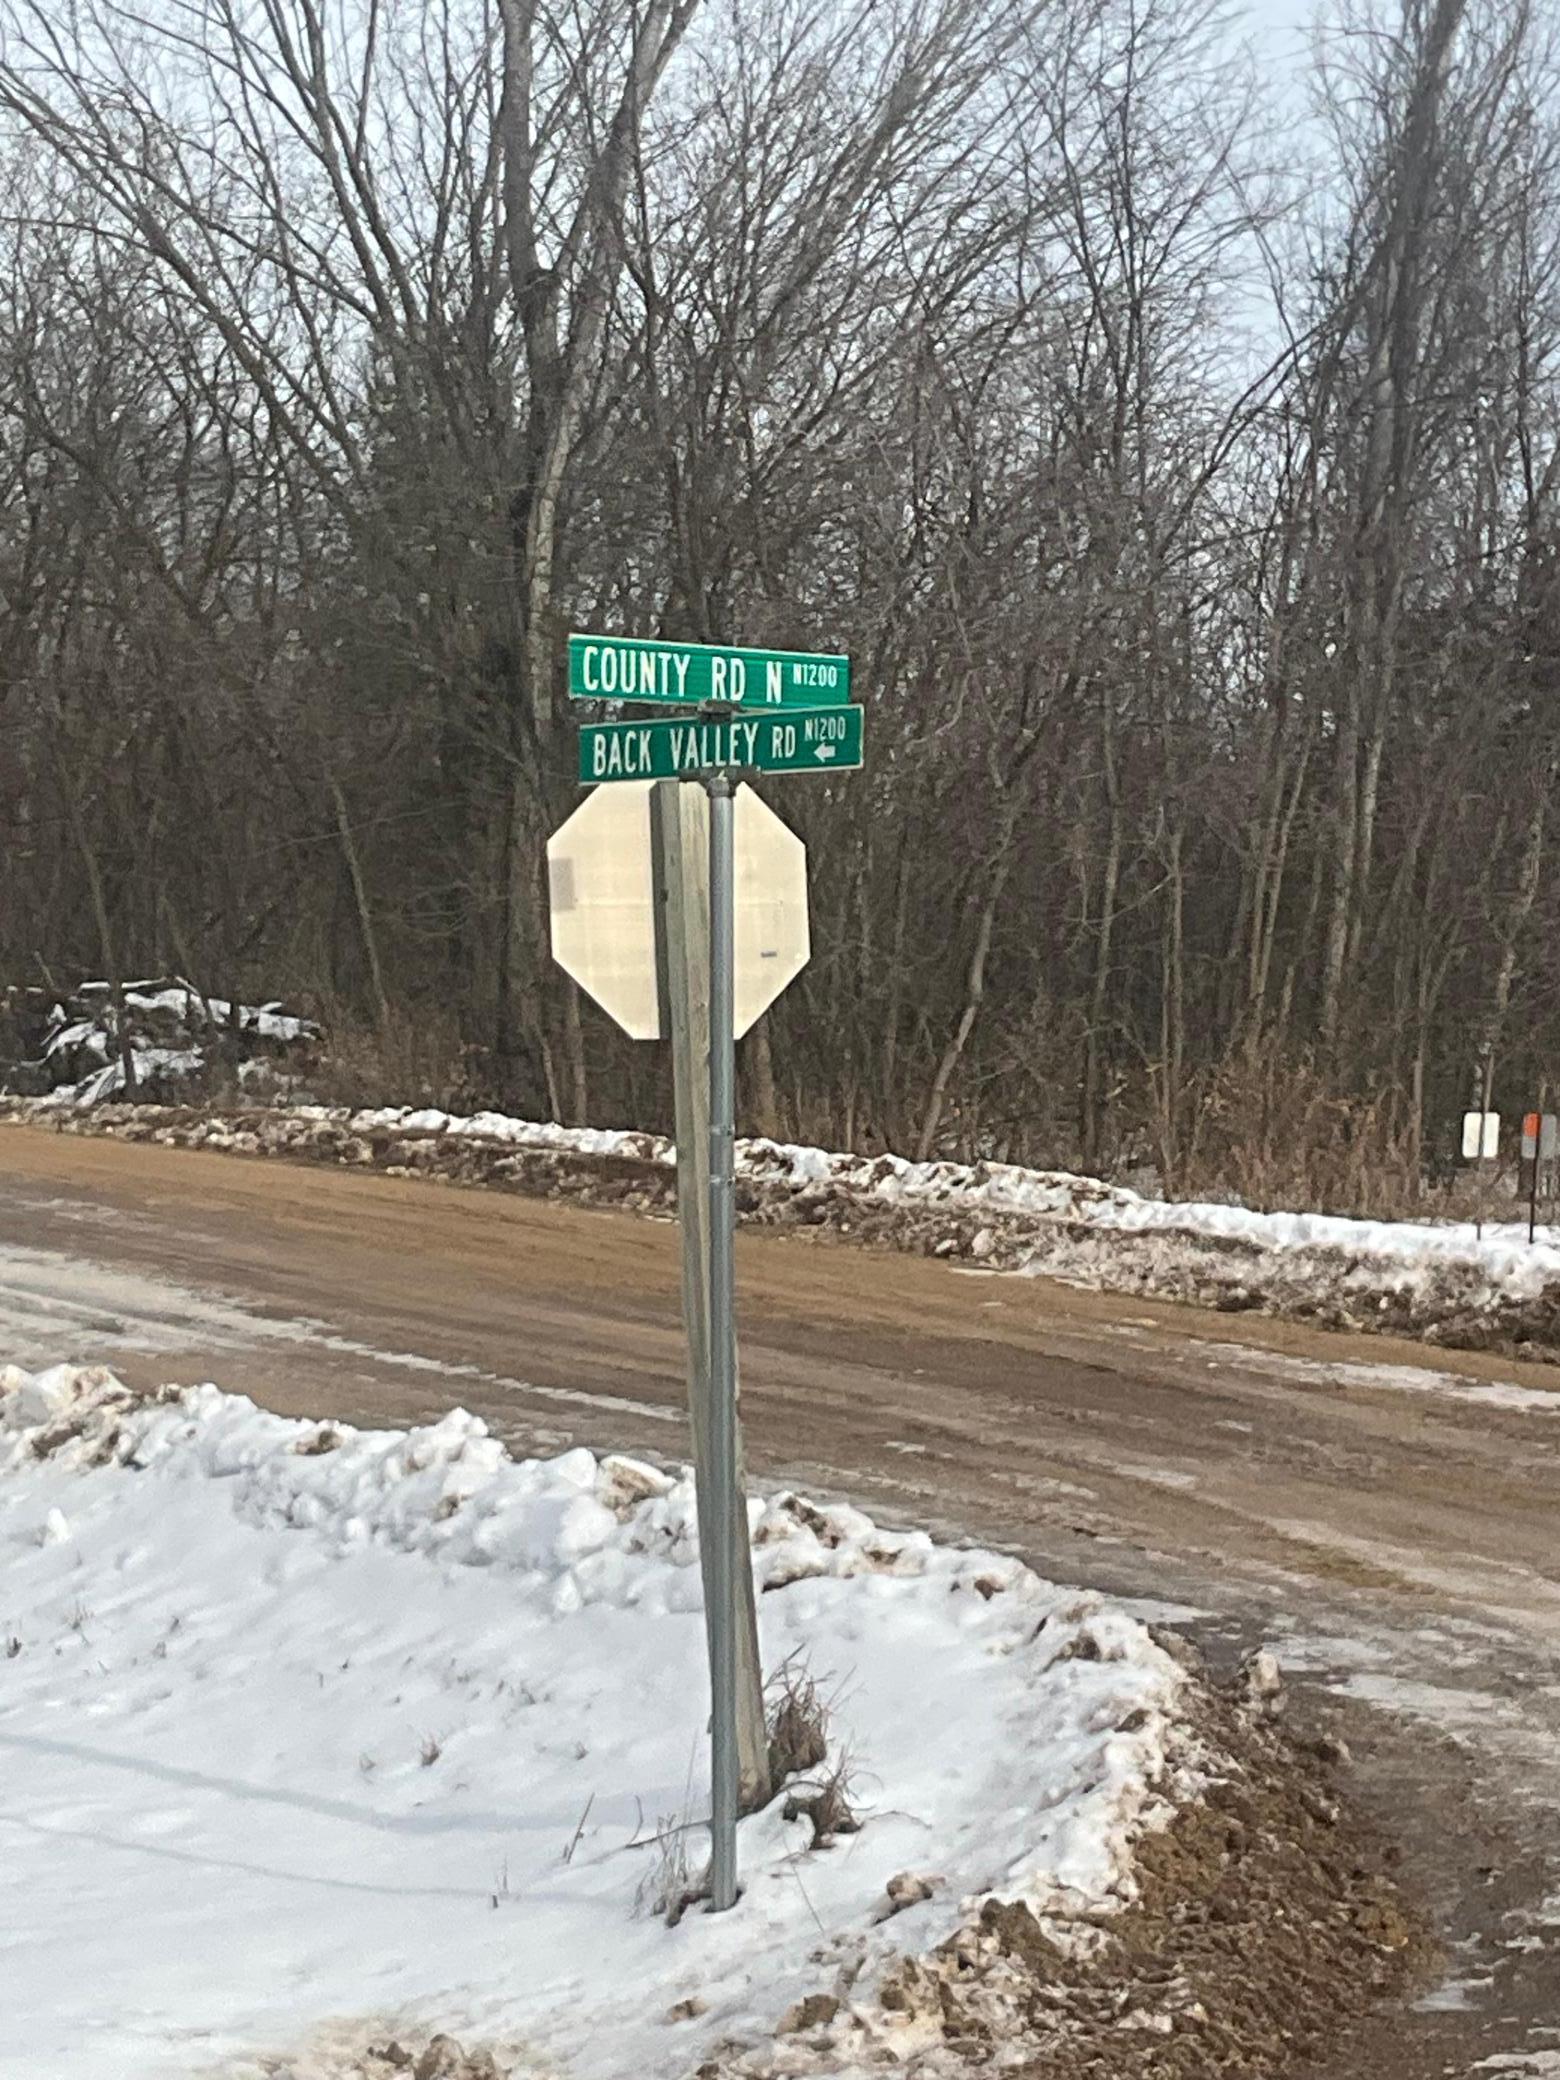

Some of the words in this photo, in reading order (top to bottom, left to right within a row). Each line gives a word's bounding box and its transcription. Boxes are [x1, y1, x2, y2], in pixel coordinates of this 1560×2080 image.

[583, 646, 691, 697] COUNTY
[711, 656, 746, 700] RD
[766, 661, 783, 704] N
[793, 663, 838, 688] N1200
[593, 729, 652, 776] BACK
[670, 722, 759, 770] VALLEY
[772, 725, 796, 759] RD
[804, 716, 846, 741] N1200
